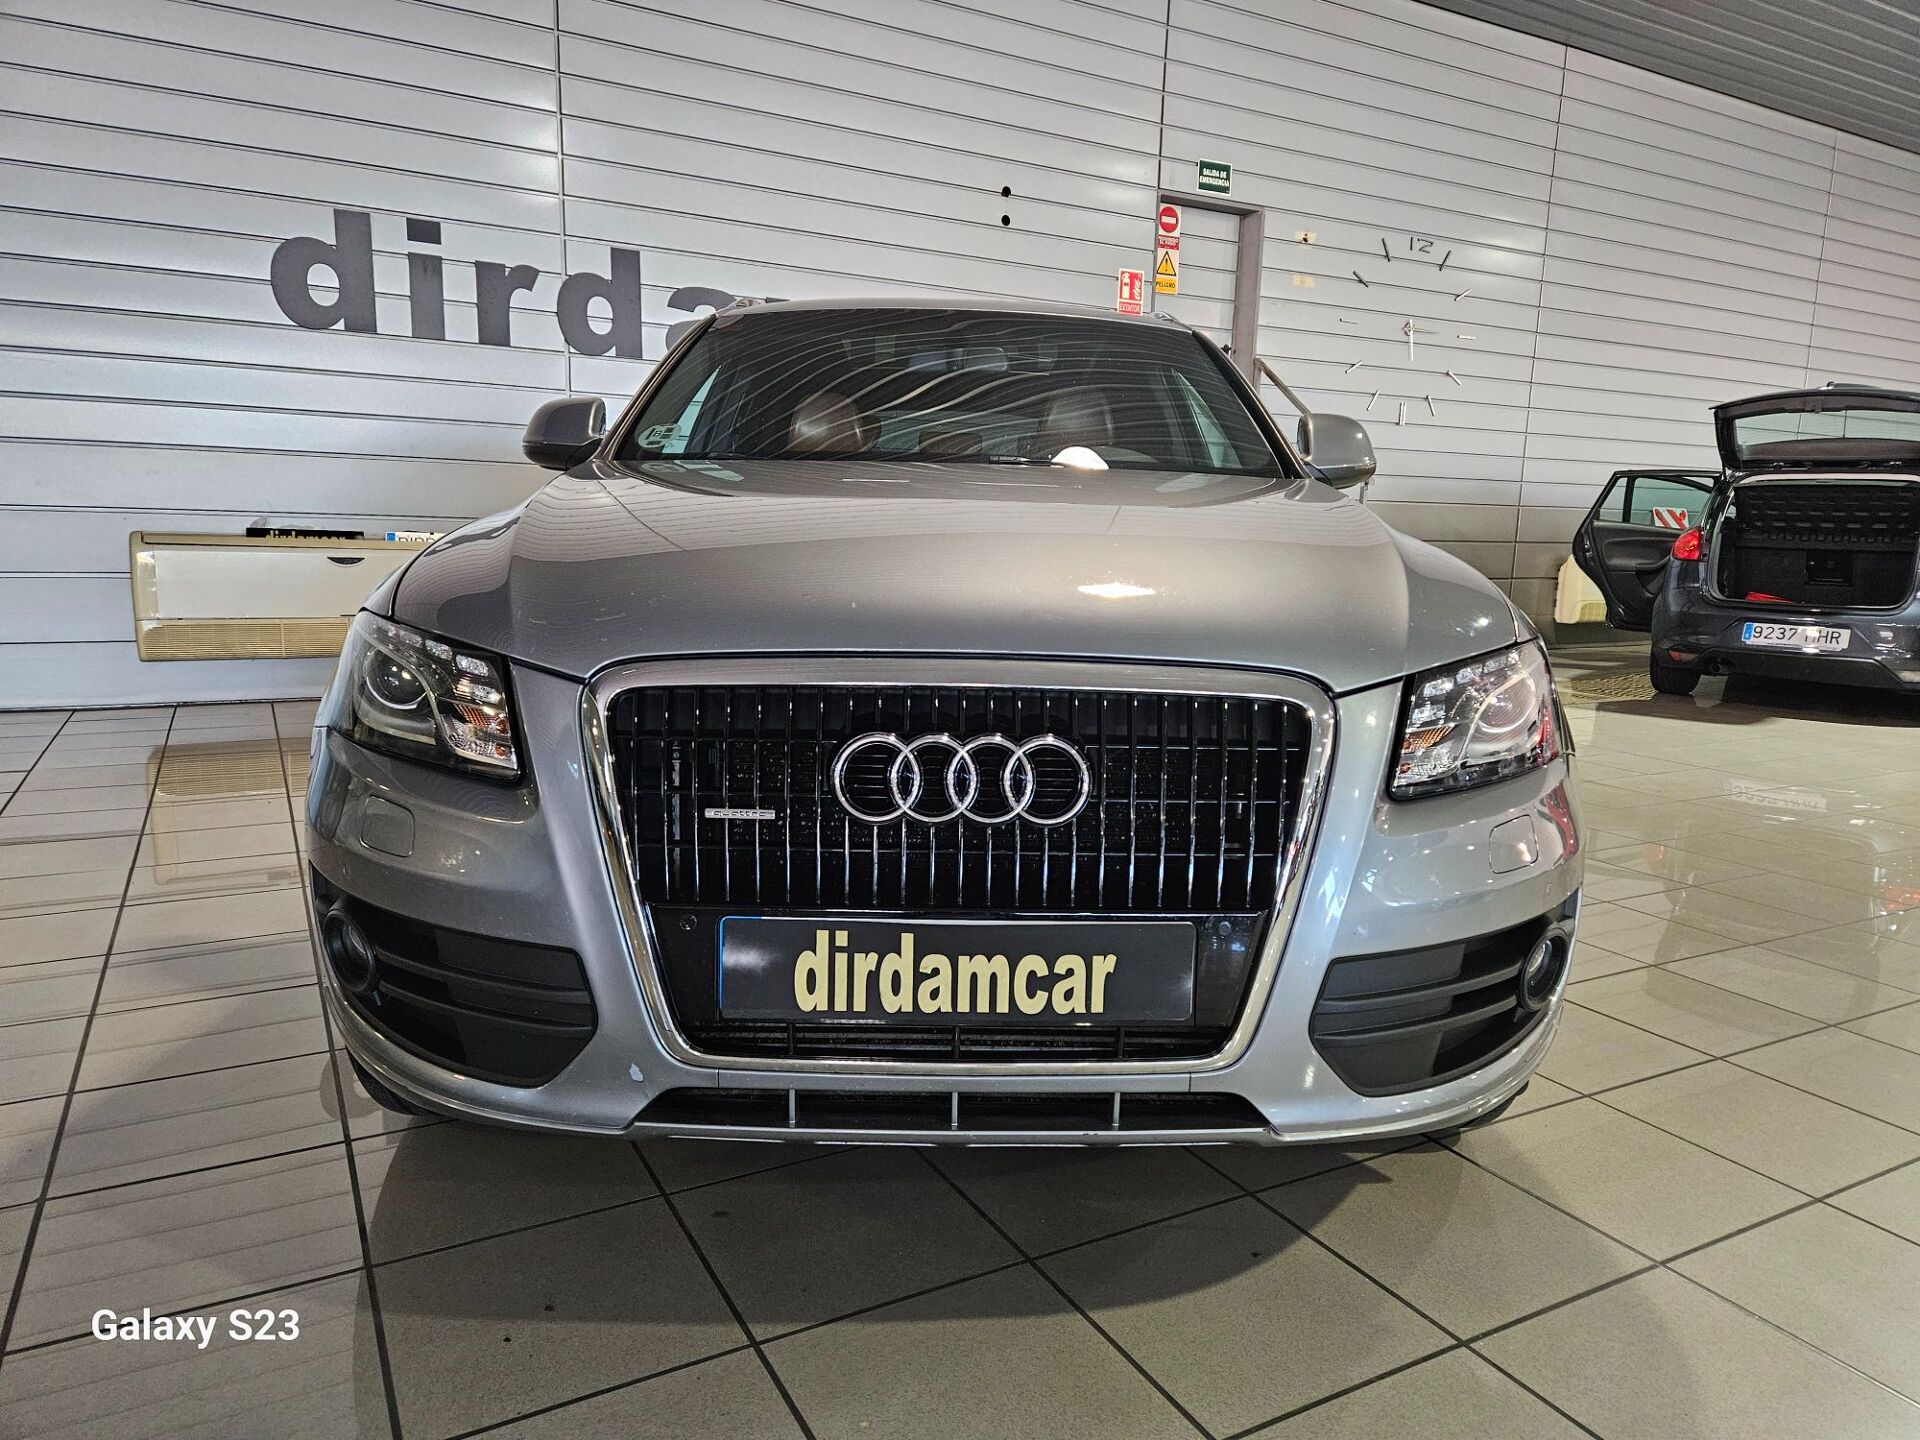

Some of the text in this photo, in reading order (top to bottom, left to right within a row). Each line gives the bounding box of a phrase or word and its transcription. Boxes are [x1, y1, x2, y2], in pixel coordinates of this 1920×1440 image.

[1203, 167, 1227, 179] SALIDA DE
[1199, 175, 1230, 187] EMERGENCIA
[1409, 236, 1434, 254] 12
[1155, 280, 1176, 289] PELIGRO
[1119, 302, 1141, 313] EXTINTOR
[1752, 625, 1798, 641] 9237
[794, 929, 1117, 1014] dirdamcar
